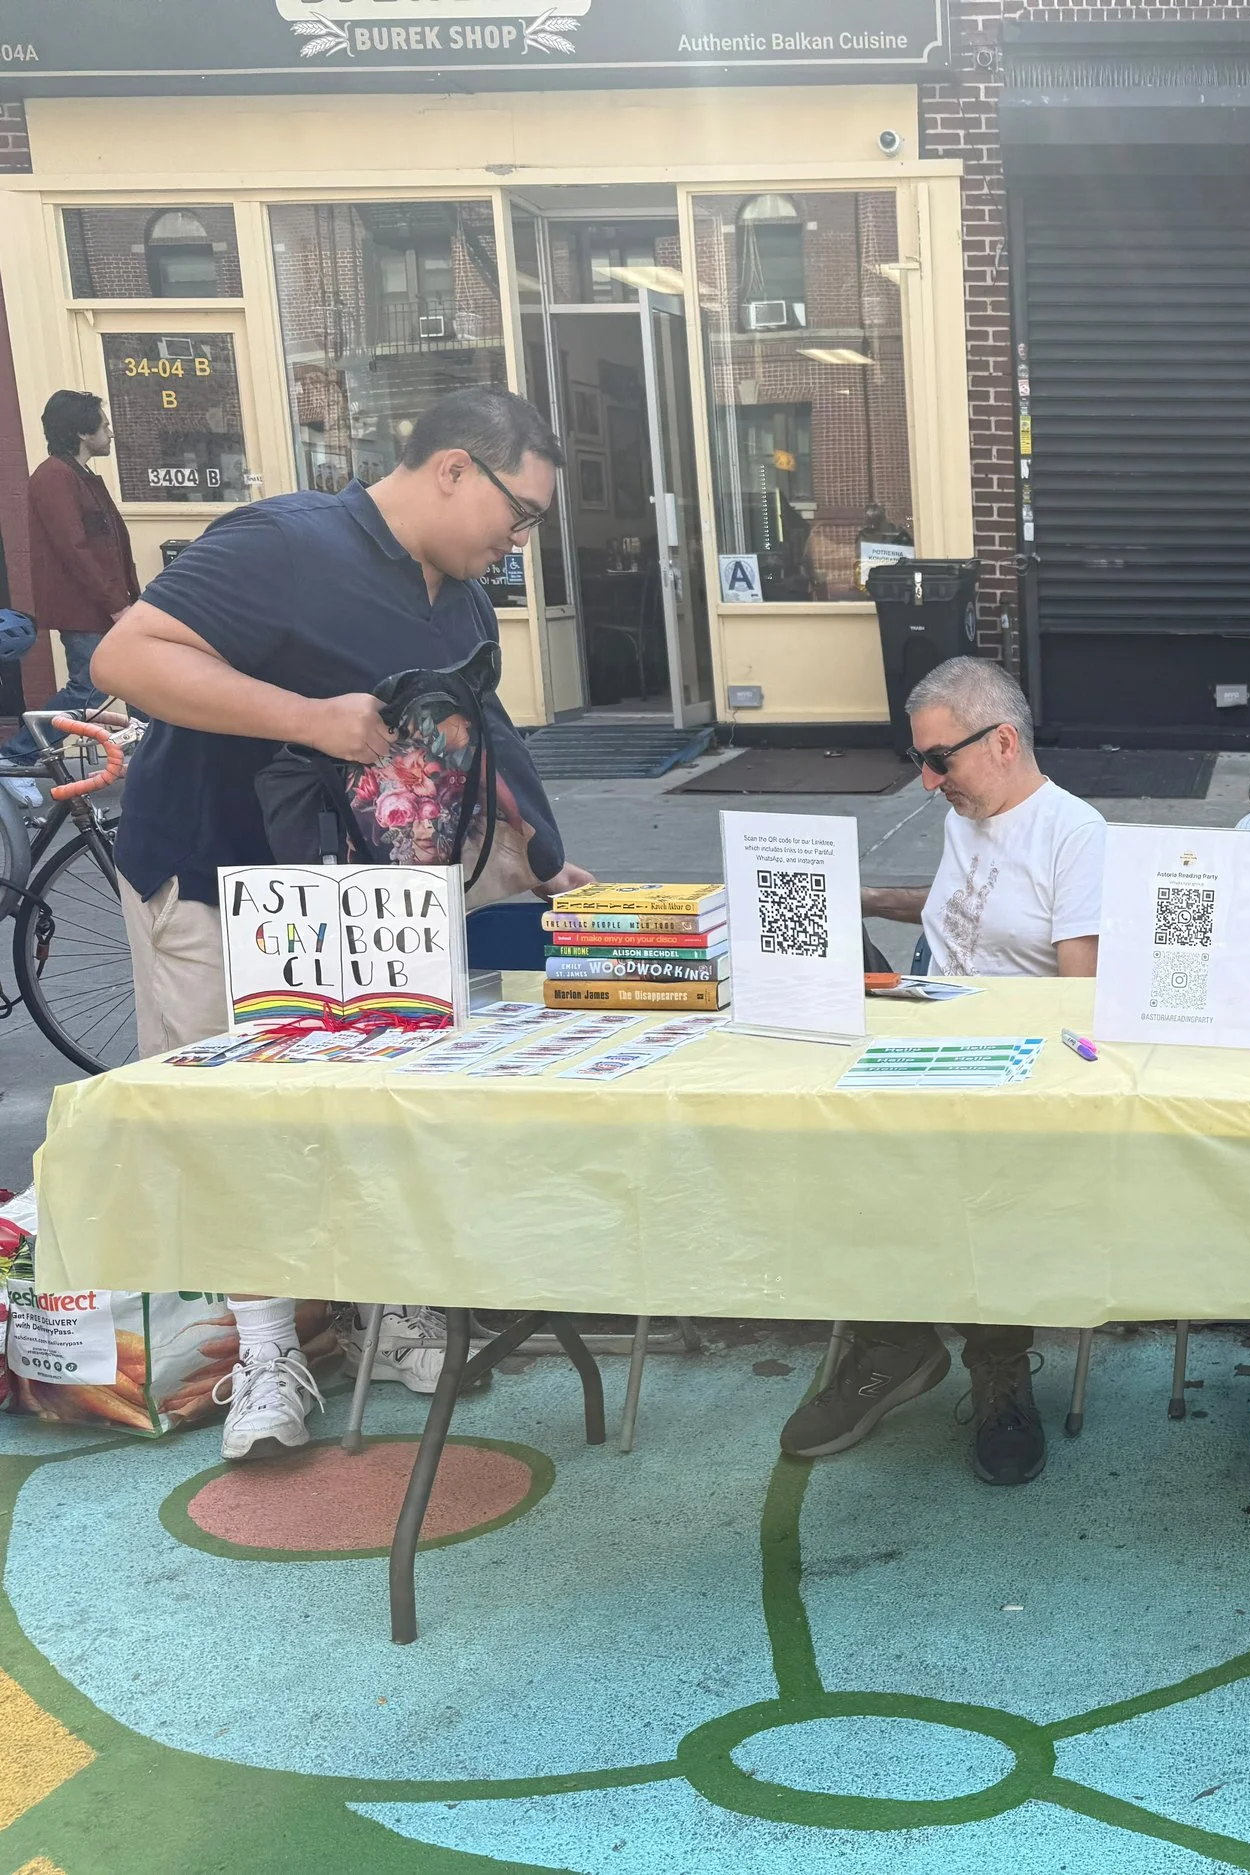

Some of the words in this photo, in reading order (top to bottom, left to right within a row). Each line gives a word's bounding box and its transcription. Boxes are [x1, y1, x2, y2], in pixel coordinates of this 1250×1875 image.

[355, 26, 441, 51] BUREK
[449, 25, 517, 49] SHOP
[678, 33, 766, 52] Authentic
[772, 32, 834, 51] Balkan
[839, 31, 907, 50] Cuisine
[124, 358, 184, 378] 34-04
[194, 358, 211, 376] B
[162, 390, 178, 408] B
[150, 470, 198, 485] 3404
[208, 470, 220, 486] B
[728, 561, 754, 590] A
[812, 839, 835, 847] Linktree,
[756, 854, 785, 864] WhatsApp,
[1178, 872, 1201, 880] Reading
[546, 920, 560, 928] THE
[564, 920, 588, 928] LILAC
[592, 921, 621, 929] PEOPLE
[654, 922, 675, 930] TODD
[256, 920, 328, 956] GAY
[346, 925, 445, 955] BOOK
[580, 935, 602, 943] make
[638, 937, 656, 945] your
[656, 936, 678, 944] disco
[560, 947, 571, 956] FUN
[572, 947, 590, 956] HOME
[644, 950, 680, 958] BECHDEL
[283, 956, 408, 988] CLUB
[589, 962, 710, 982] WOODWORKING
[554, 990, 582, 1000] Marlon
[584, 990, 610, 1000] James
[618, 990, 632, 1000] The
[634, 990, 688, 1002] Disappearers
[26, 1313, 41, 1322] FREE
[42, 1317, 78, 1326] DELIVERY
[16, 1322, 30, 1330] with
[32, 1324, 74, 1336] DeliveryPass.
